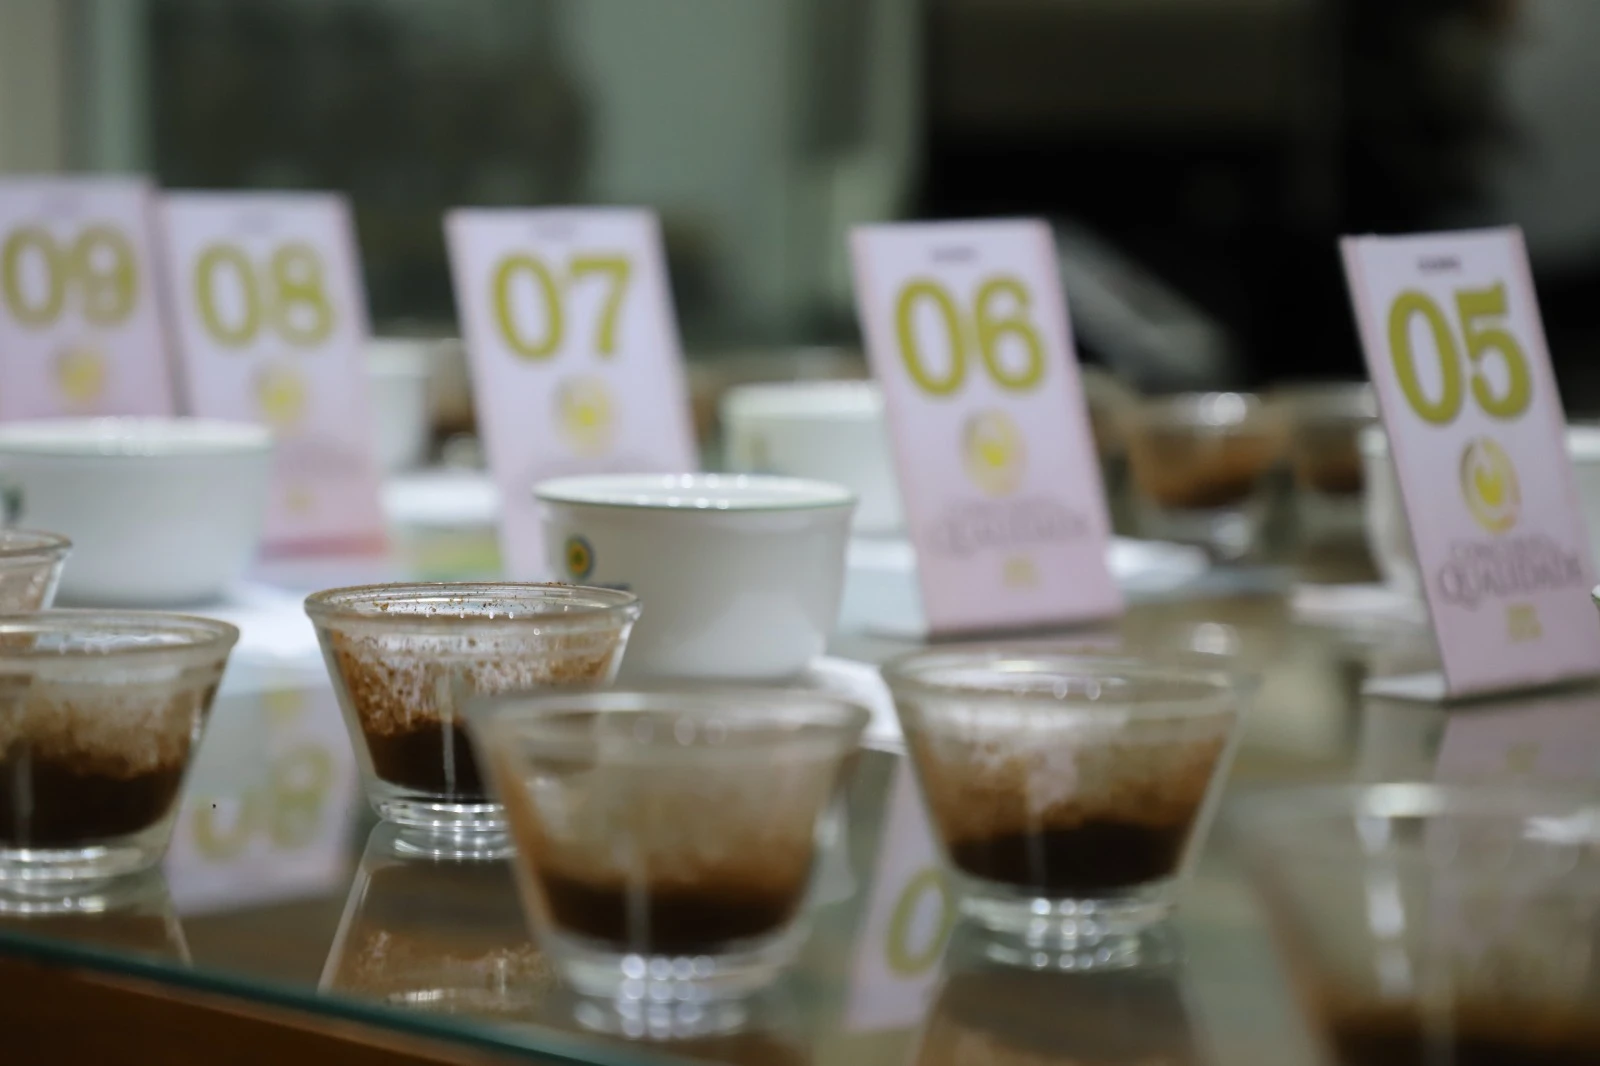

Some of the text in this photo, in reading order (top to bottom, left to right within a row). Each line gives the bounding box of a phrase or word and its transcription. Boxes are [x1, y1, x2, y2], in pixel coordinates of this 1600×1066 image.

[1, 226, 139, 327] 09
[194, 243, 334, 346] 08
[491, 253, 632, 361] 07
[894, 276, 1046, 397] 06
[1387, 280, 1531, 425] 05
